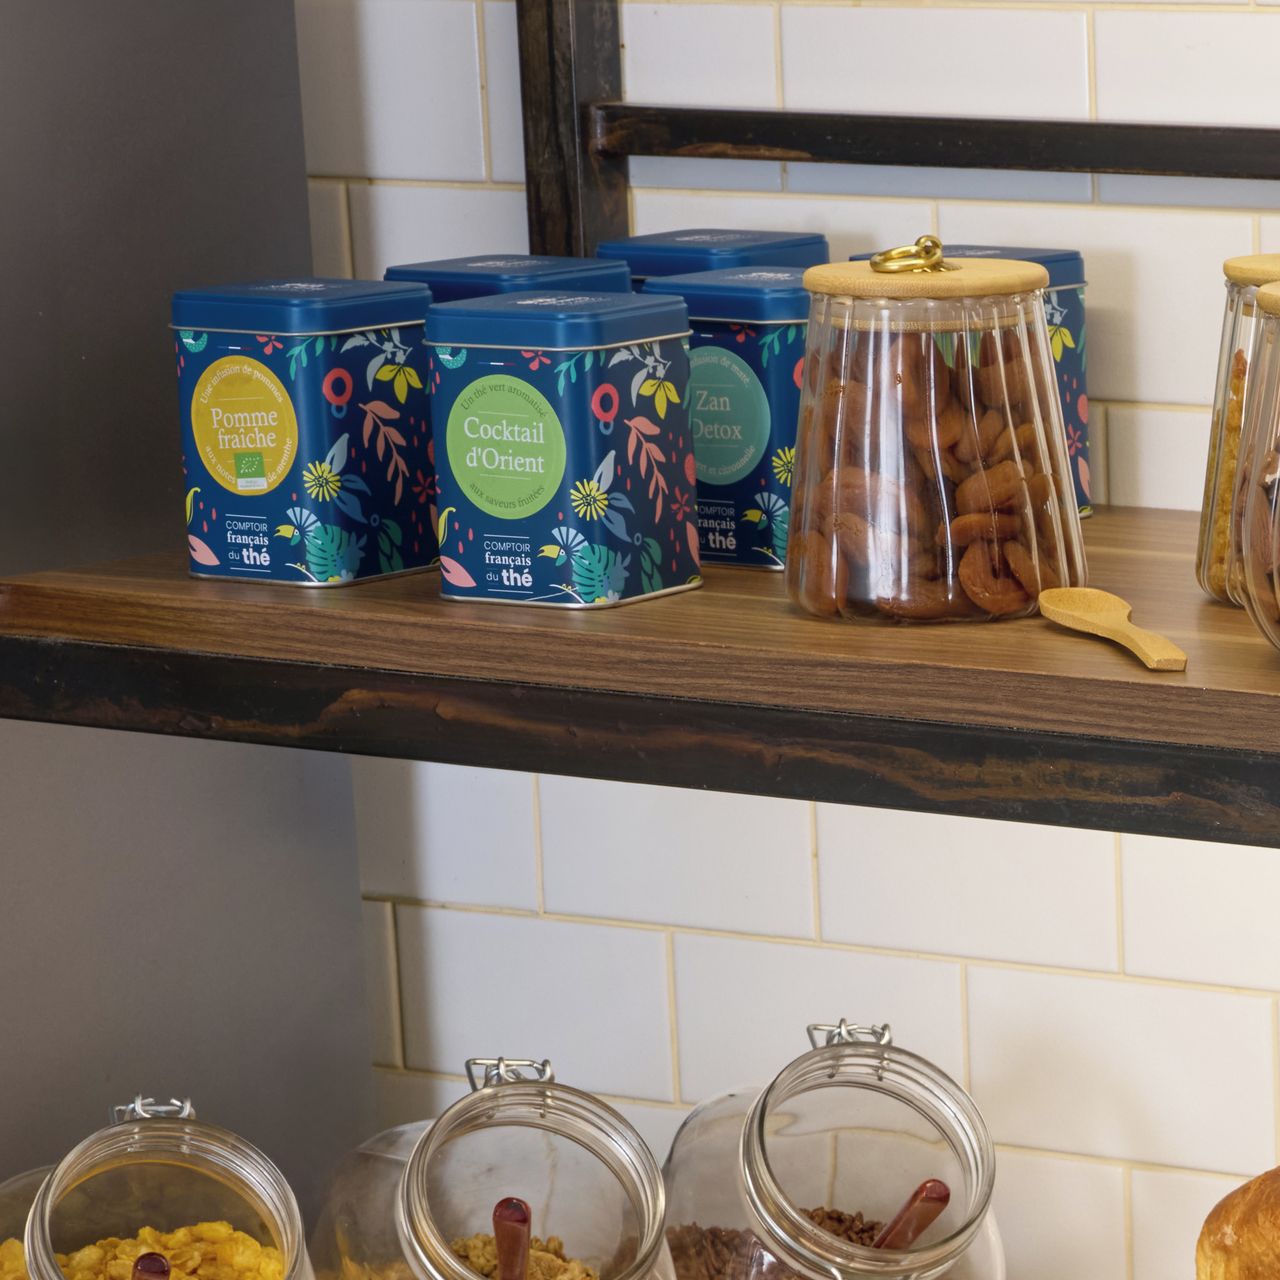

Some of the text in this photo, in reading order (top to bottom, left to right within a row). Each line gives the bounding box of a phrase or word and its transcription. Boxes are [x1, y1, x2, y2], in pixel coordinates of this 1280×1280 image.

[200, 381, 213, 404] Une
[242, 364, 253, 375] de
[460, 383, 547, 417] Un thé vert aromatisé
[696, 390, 731, 411] Zan
[210, 408, 278, 429] Pomme
[218, 427, 277, 449] fraîche
[463, 416, 545, 444] Cocktail
[205, 445, 217, 465] aux
[216, 463, 235, 484] notes
[267, 471, 277, 482] de
[276, 436, 293, 473] menthe
[466, 446, 545, 473] d'Orient
[469, 483, 545, 509] aux saveurs fruitées
[699, 506, 735, 516] OMPTOIR
[225, 520, 268, 532] COMPTOIR
[698, 517, 736, 531] rançais
[227, 530, 269, 547] français
[483, 540, 531, 552] COMPTOIR
[708, 531, 736, 550] thé
[228, 547, 270, 566] du thé
[485, 551, 532, 568] français
[486, 568, 533, 587] du thé
